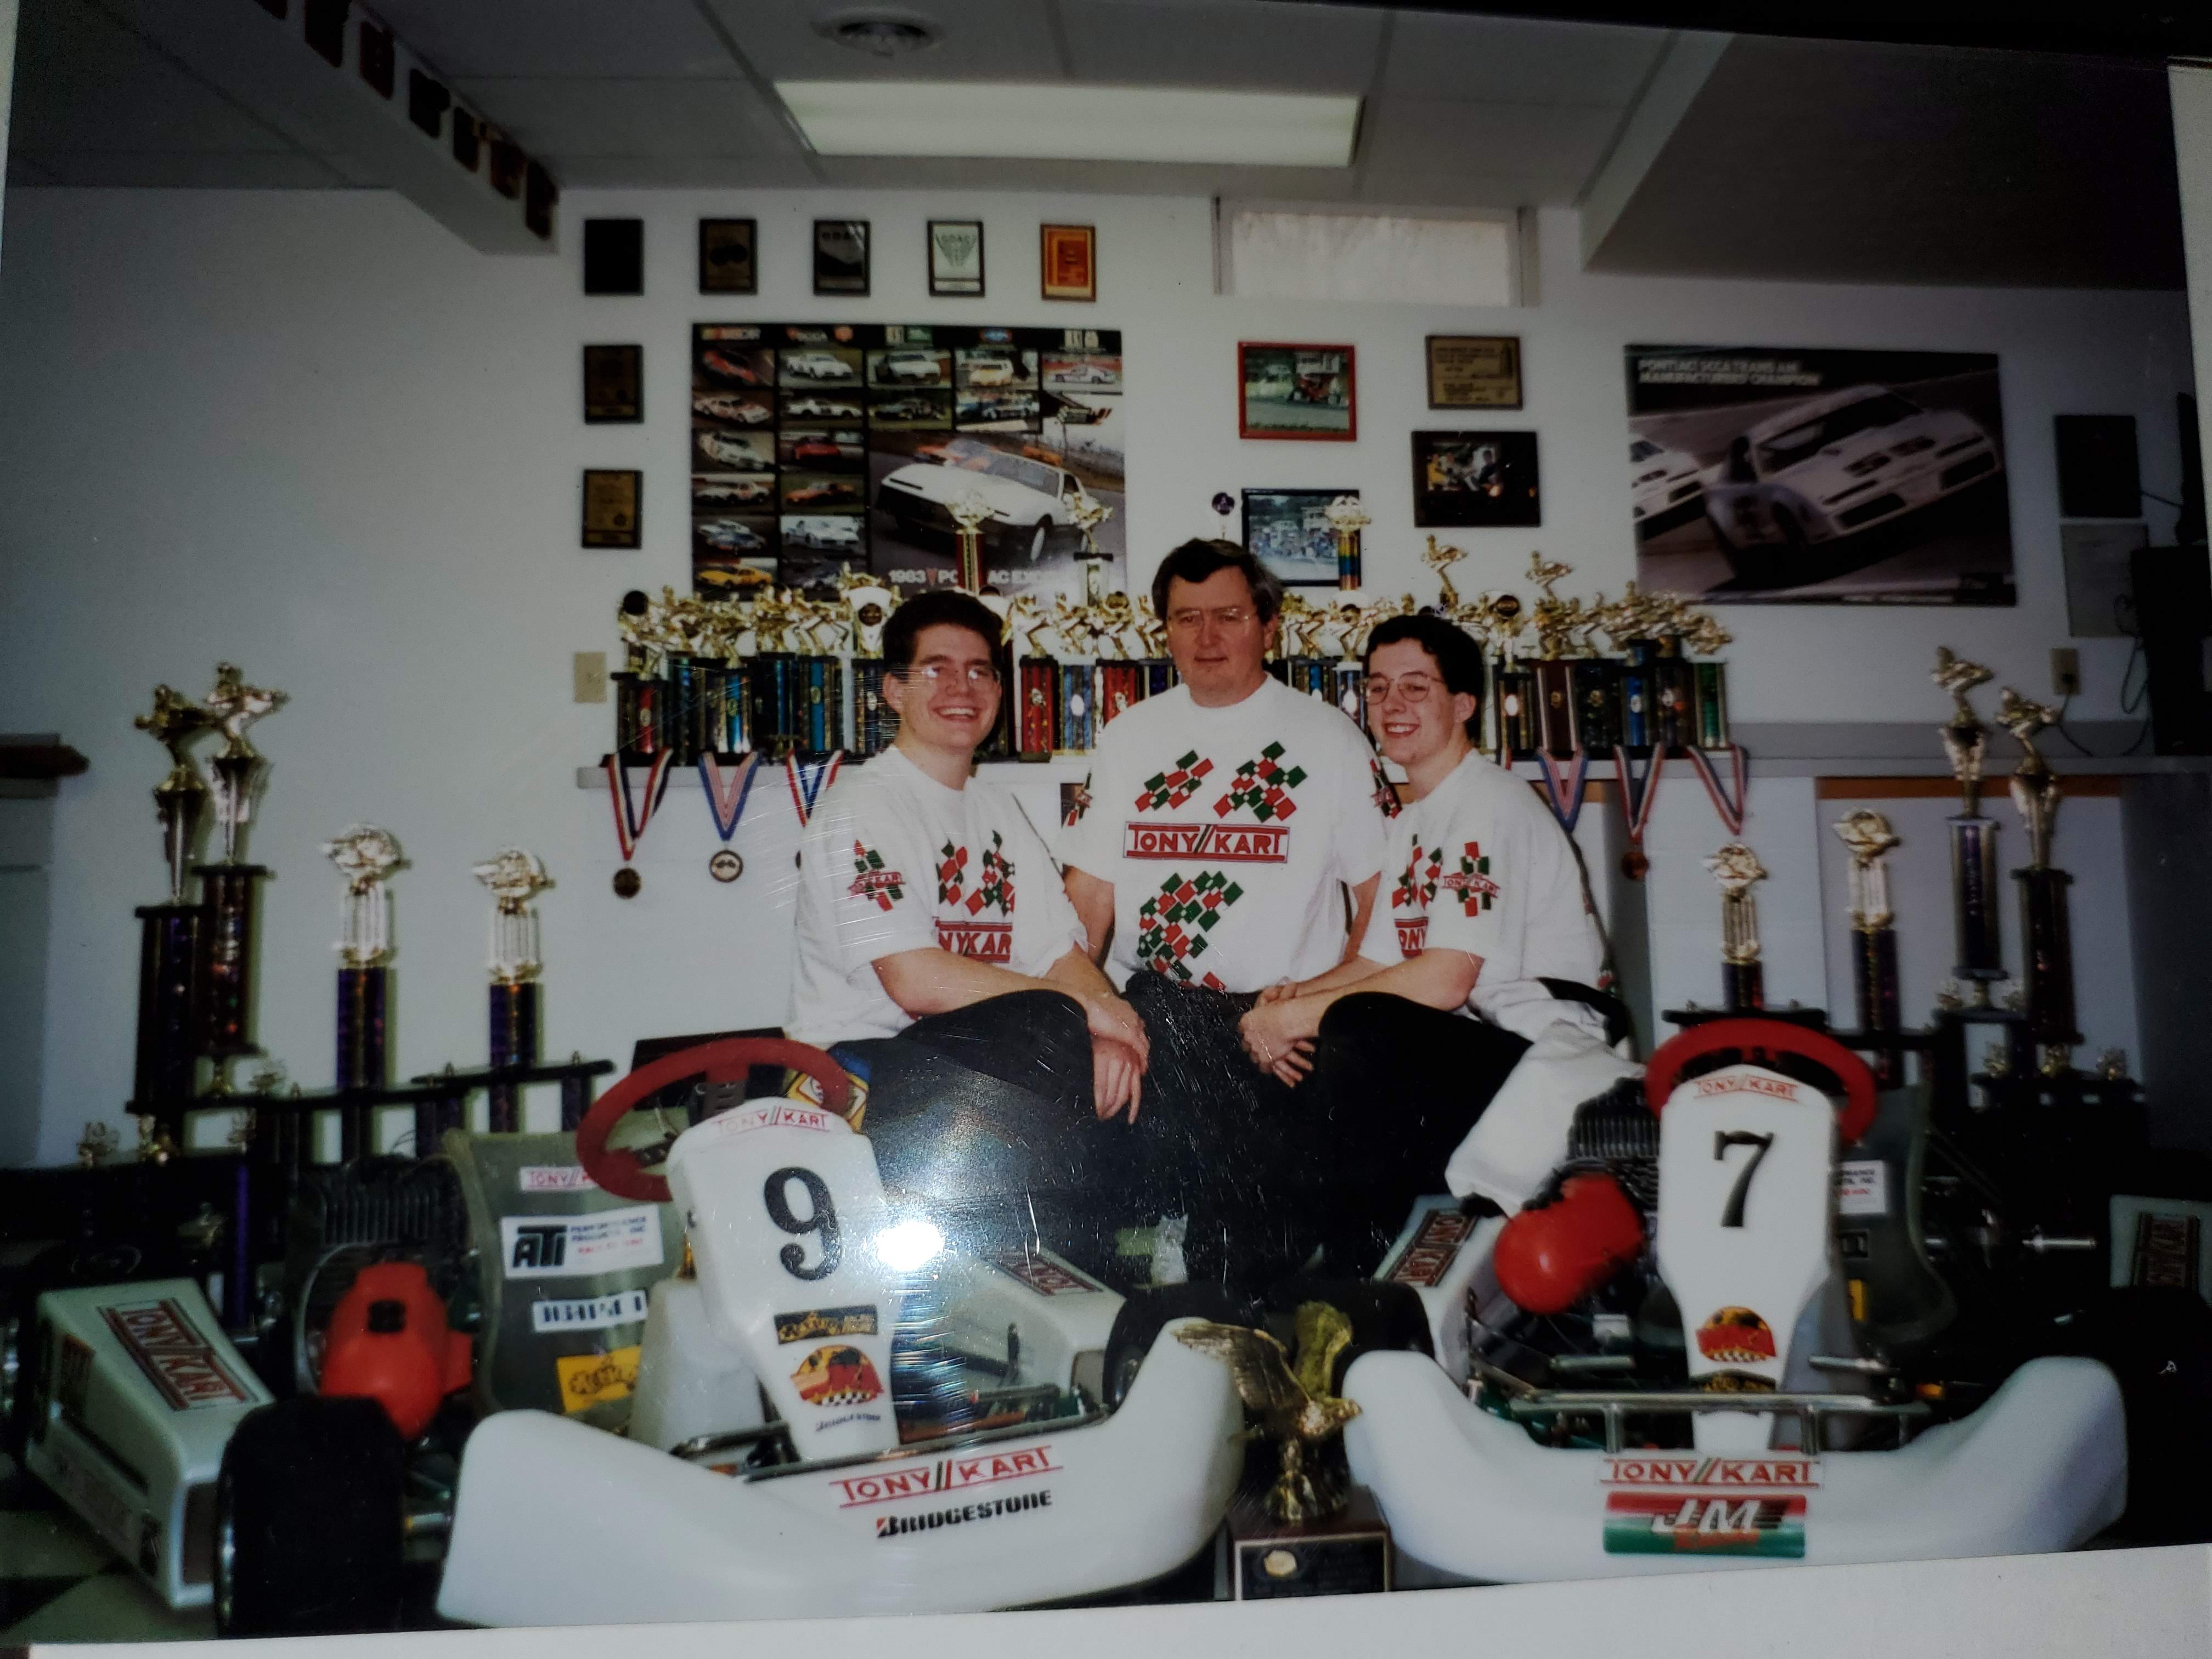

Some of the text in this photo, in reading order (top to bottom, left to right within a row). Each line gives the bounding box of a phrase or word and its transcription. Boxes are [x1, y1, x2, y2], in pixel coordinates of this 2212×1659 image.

[889, 569, 926, 583] 1983
[1714, 1130, 1773, 1228] 7
[512, 1224, 568, 1268] ATI
[763, 1166, 843, 1282] 9
[876, 1490, 1052, 1538] BRIDGESTONE
